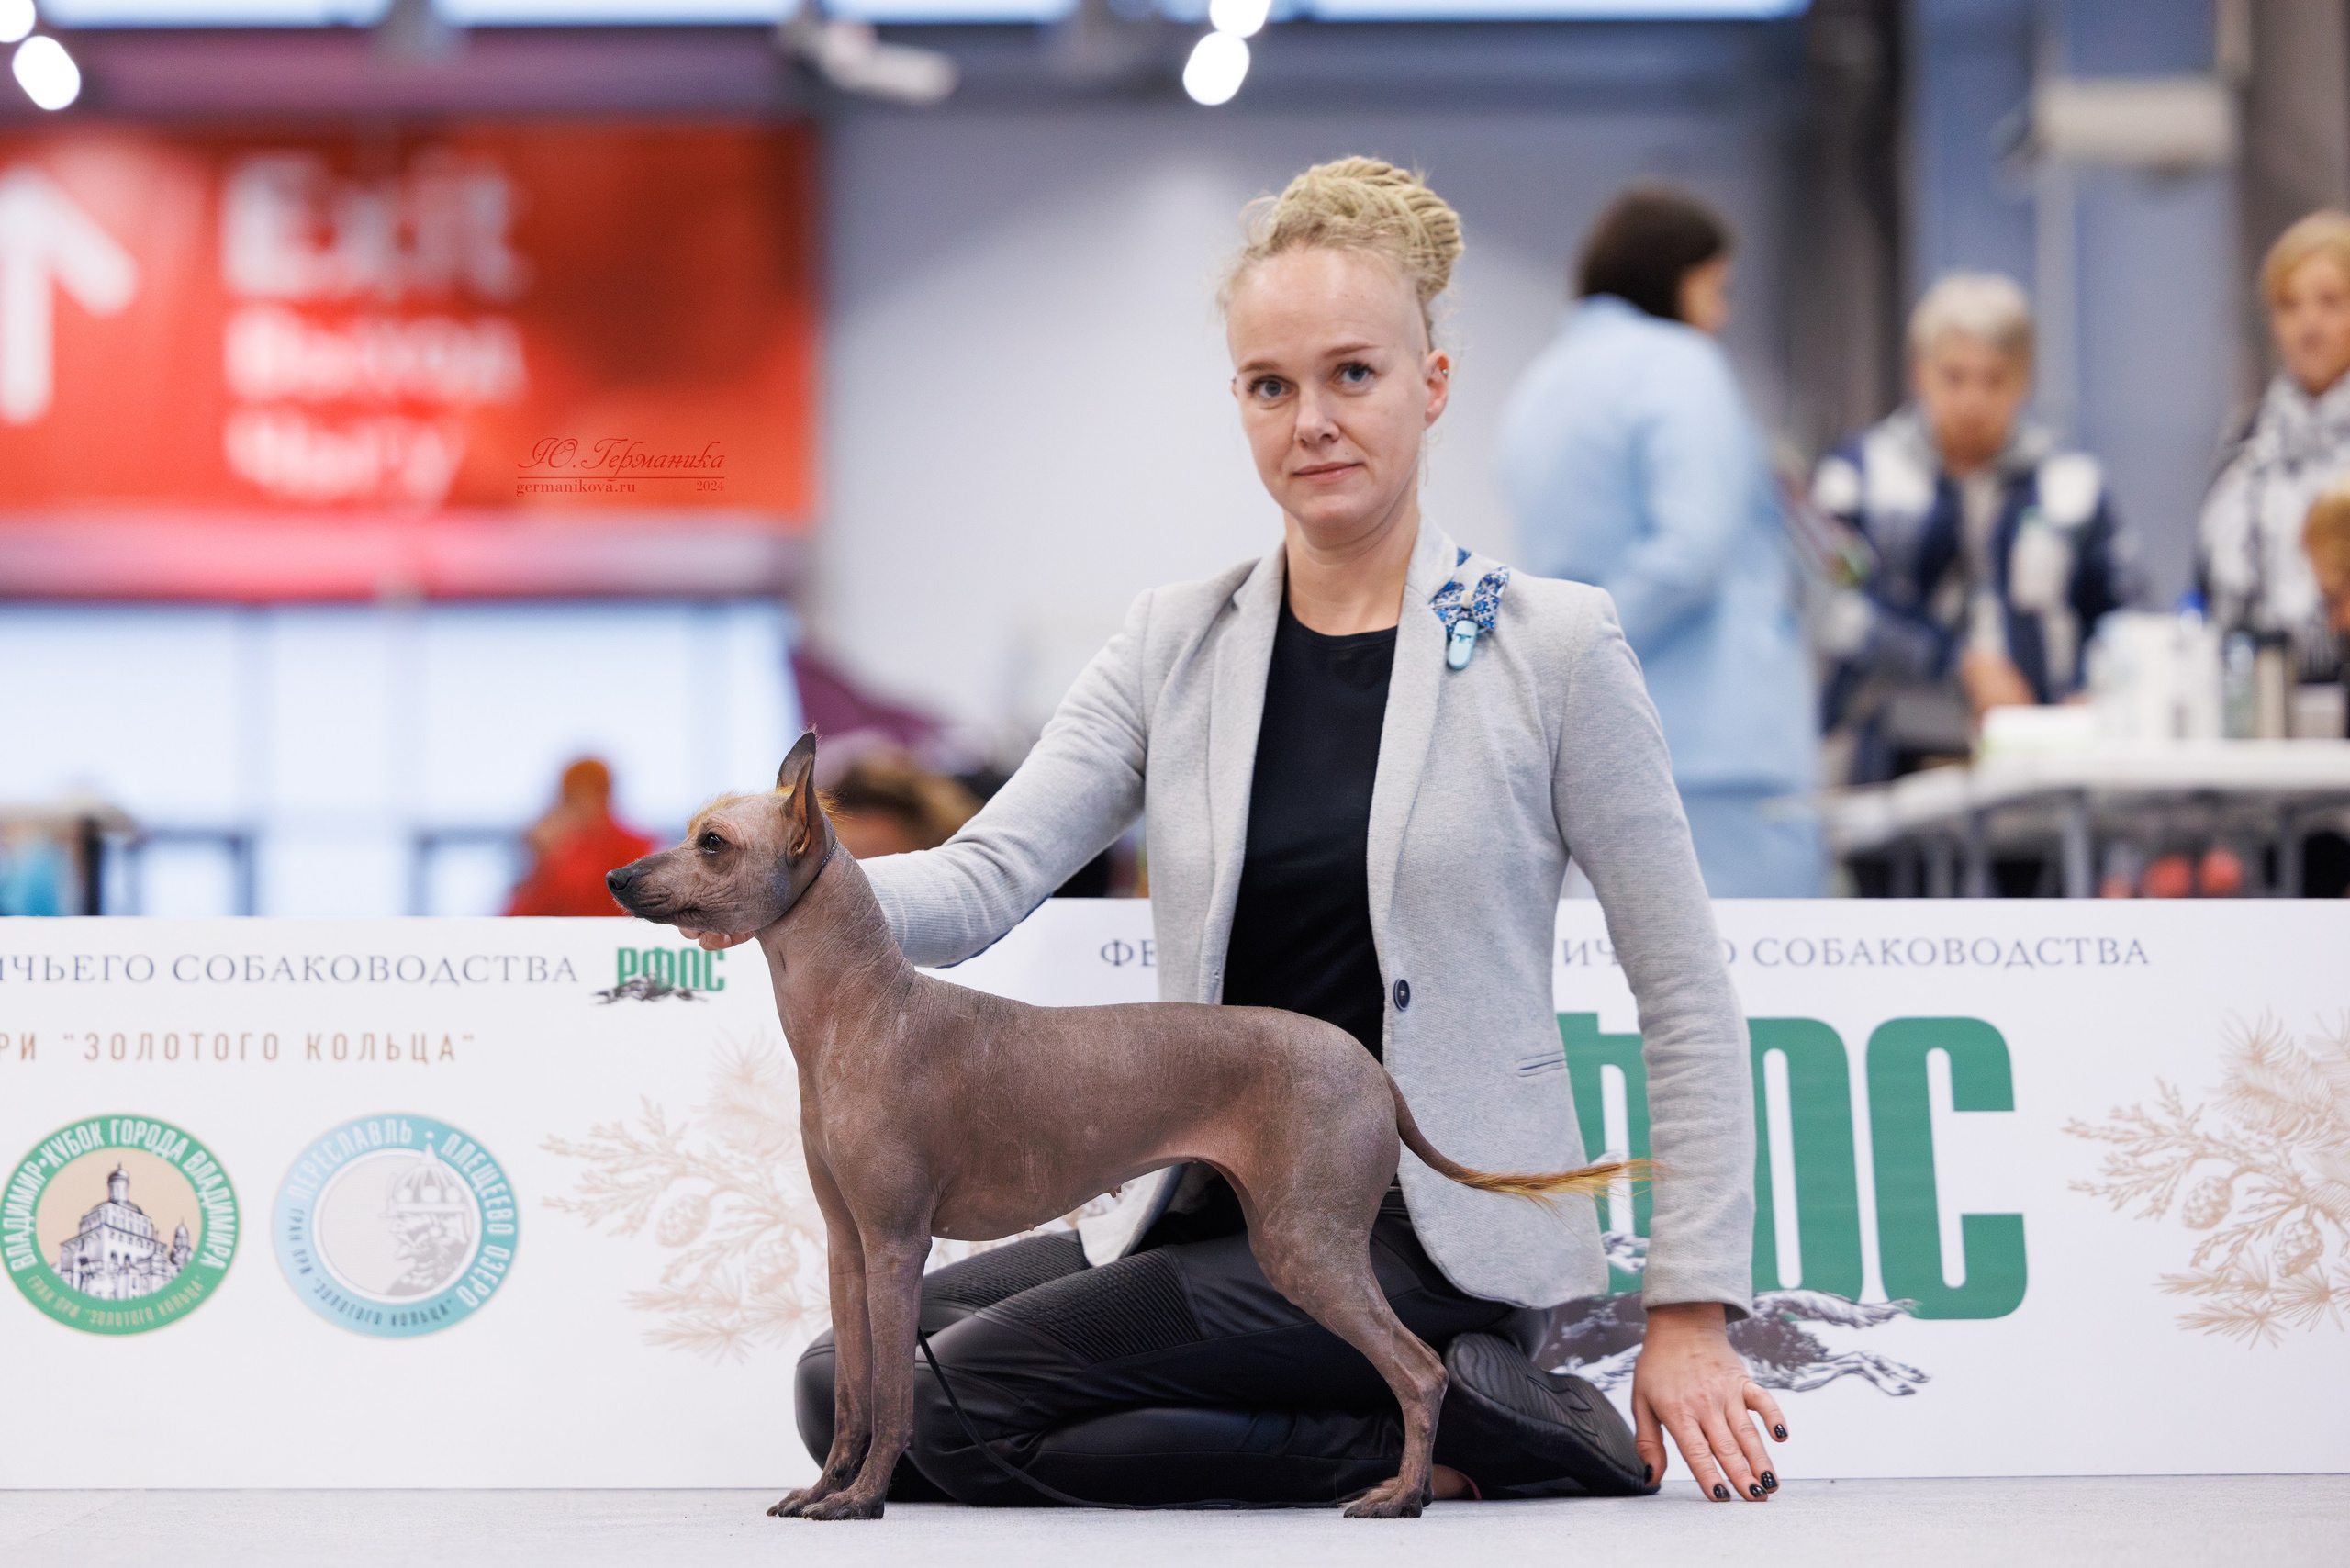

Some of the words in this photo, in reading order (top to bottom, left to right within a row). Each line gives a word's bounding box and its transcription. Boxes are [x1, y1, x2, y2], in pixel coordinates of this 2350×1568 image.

[0, 953, 154, 982] ЧЬЕГО
[173, 953, 579, 987] СОБАКОВОДСТВА
[1752, 937, 2151, 970] СОБАКОВОДСТВА
[63, 1032, 279, 1061] "ЗОЛОТОГО
[306, 1032, 475, 1065] КОЛЬЦА"
[286, 1118, 413, 1201] ПЕРЕСЛАВЛЬ
[439, 1132, 515, 1236] ПЛЕЩЕЕВО
[110, 1118, 190, 1163] ГОРОДА
[182, 1149, 236, 1271] ВЛАДИМИРА
[455, 1243, 511, 1308] ОЗЕРО
